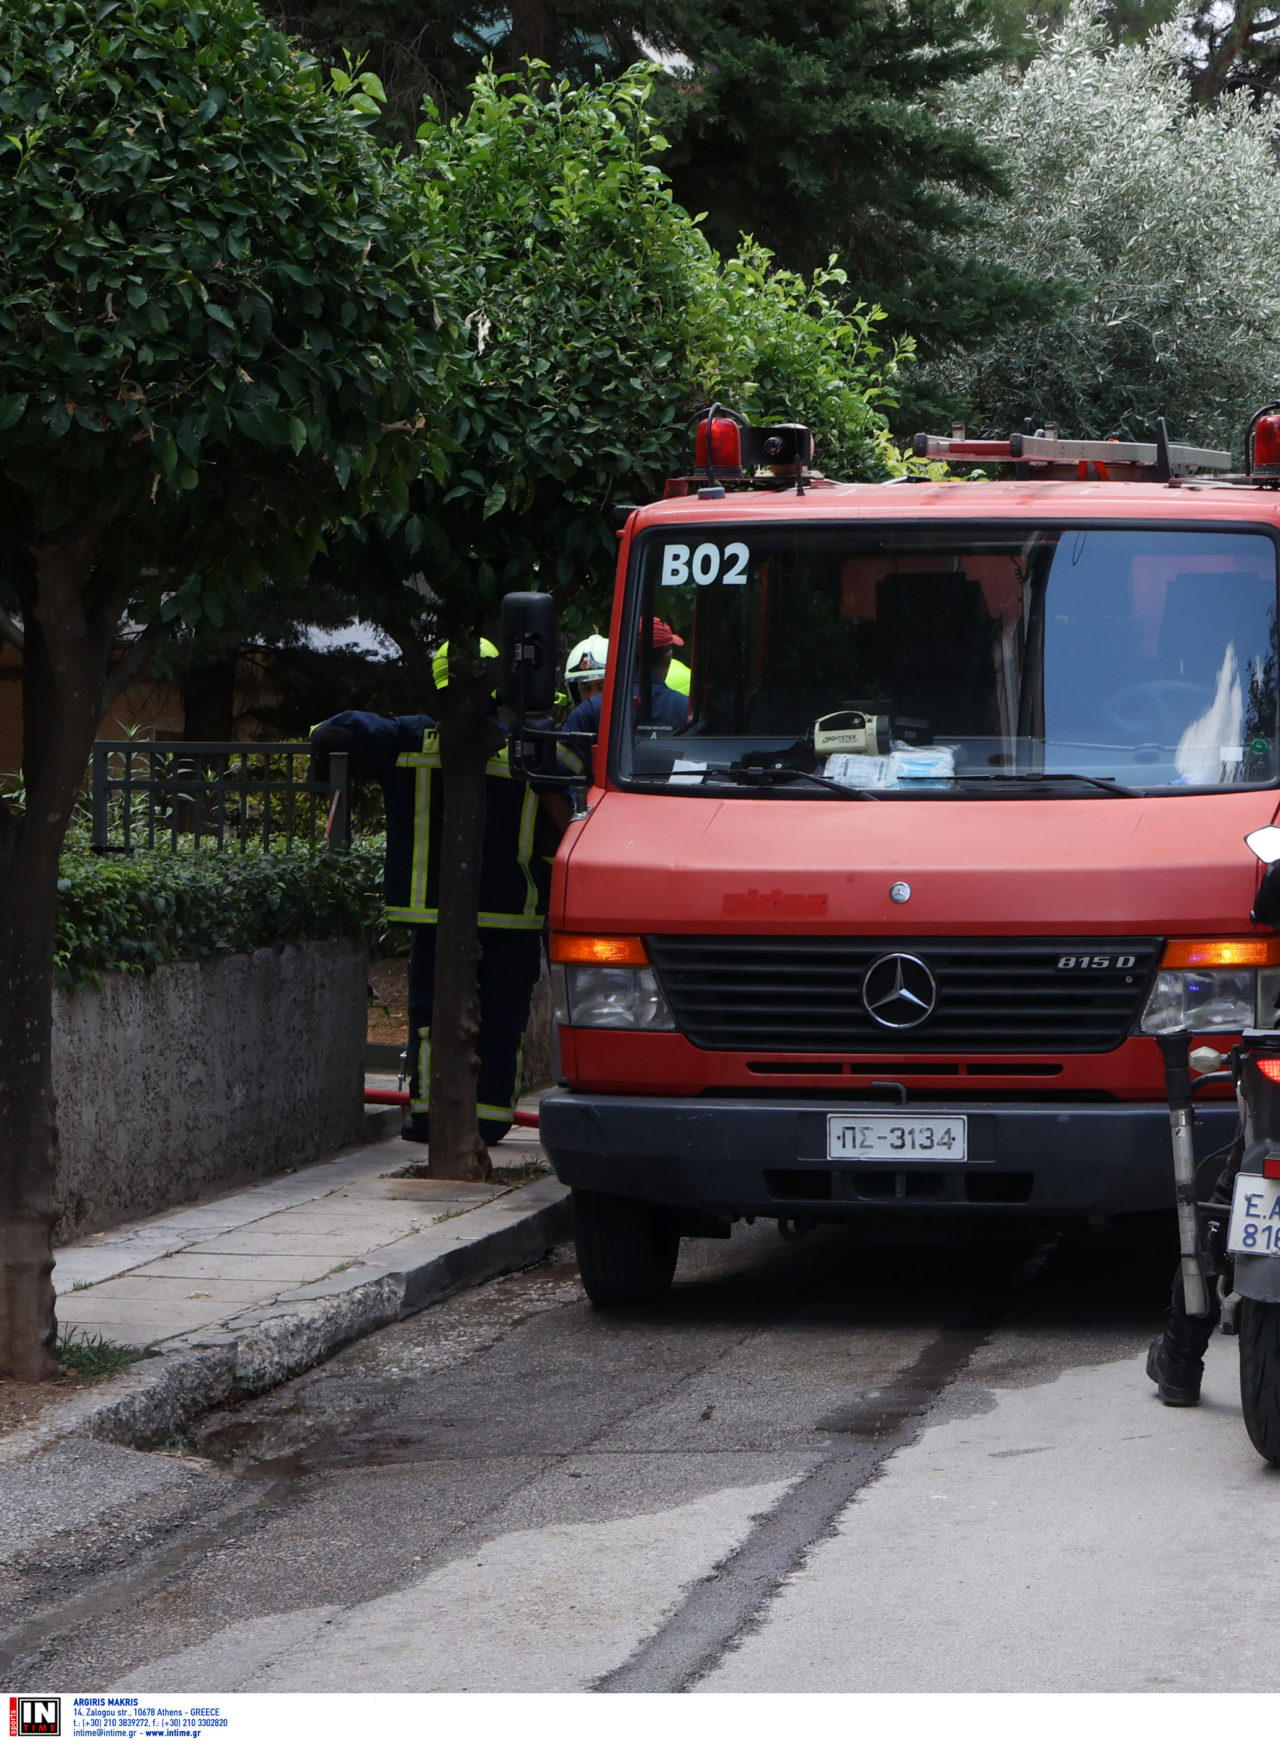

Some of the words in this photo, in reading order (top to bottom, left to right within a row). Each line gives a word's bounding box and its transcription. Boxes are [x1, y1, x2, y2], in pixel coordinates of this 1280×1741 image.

[661, 541, 750, 586] B02
[1058, 956, 1110, 968] 815
[1116, 956, 1135, 968] D
